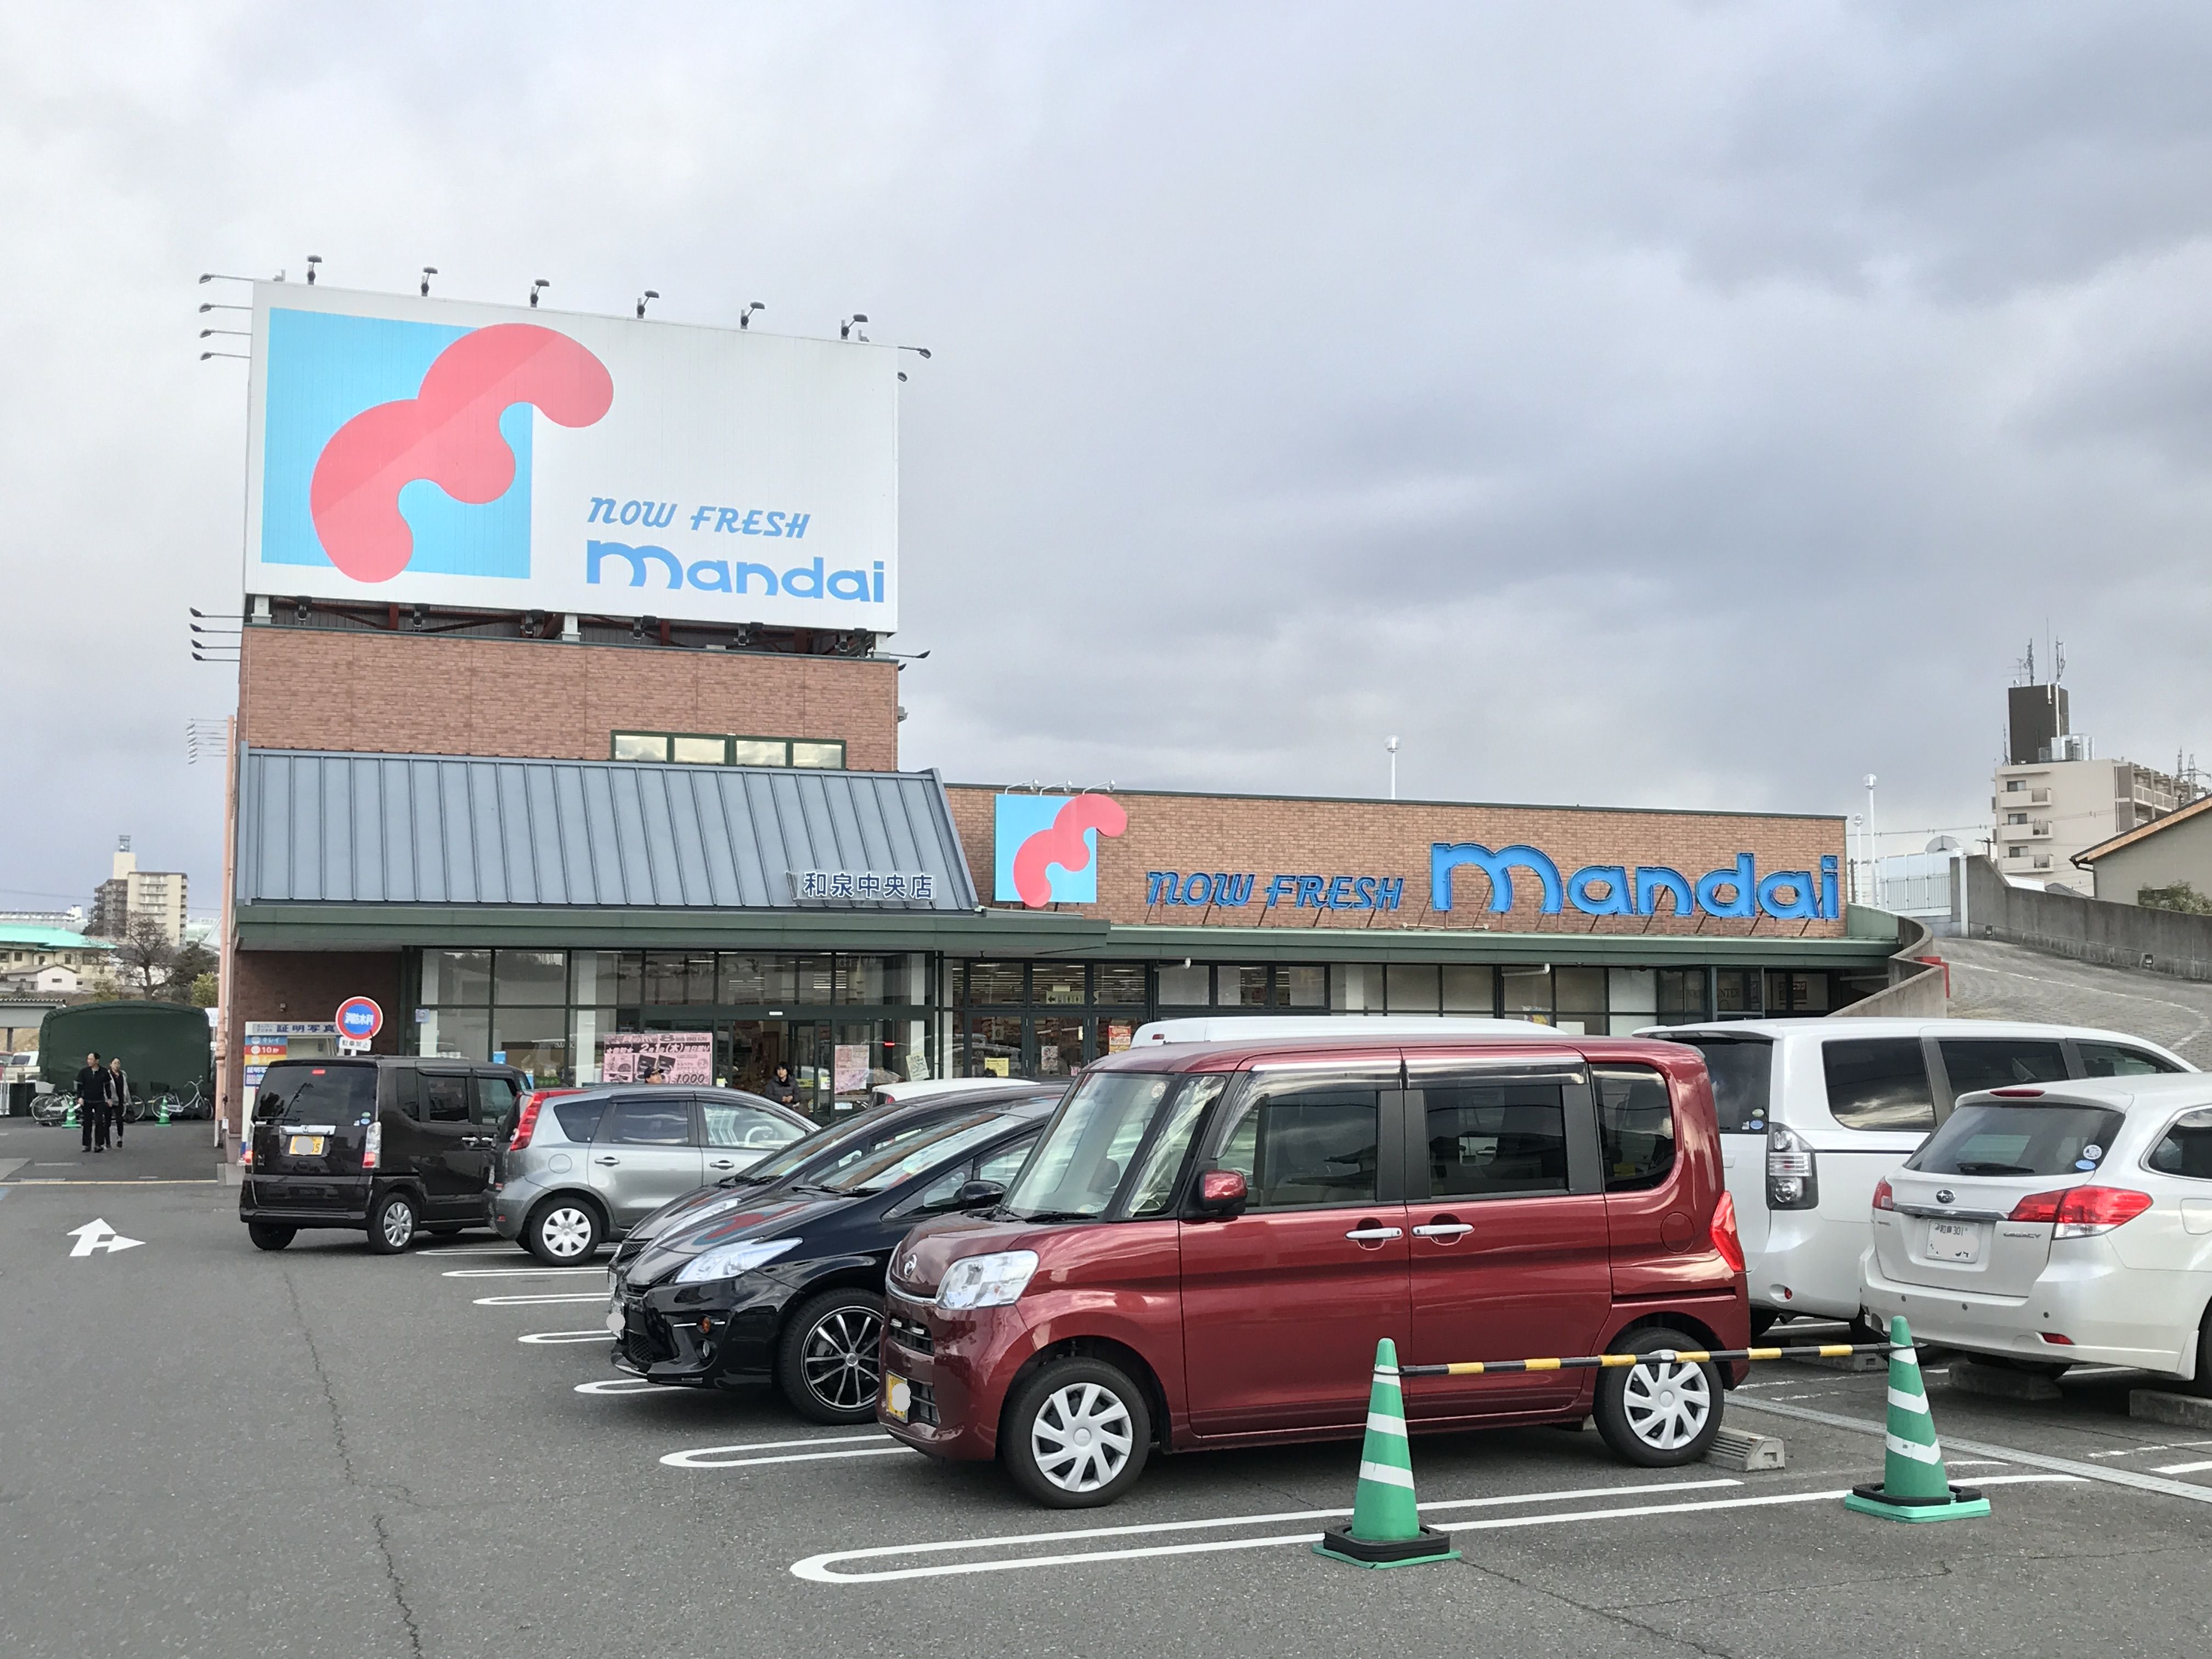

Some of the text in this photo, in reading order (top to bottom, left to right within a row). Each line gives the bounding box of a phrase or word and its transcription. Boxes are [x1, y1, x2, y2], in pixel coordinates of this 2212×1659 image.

[690, 505, 811, 539] FRESH
[586, 539, 884, 603] mandai
[803, 871, 934, 900] 和泉中央店
[1266, 874, 1404, 911] FRESH
[1431, 842, 1839, 919] mandai
[276, 1024, 335, 1032] 証明写真
